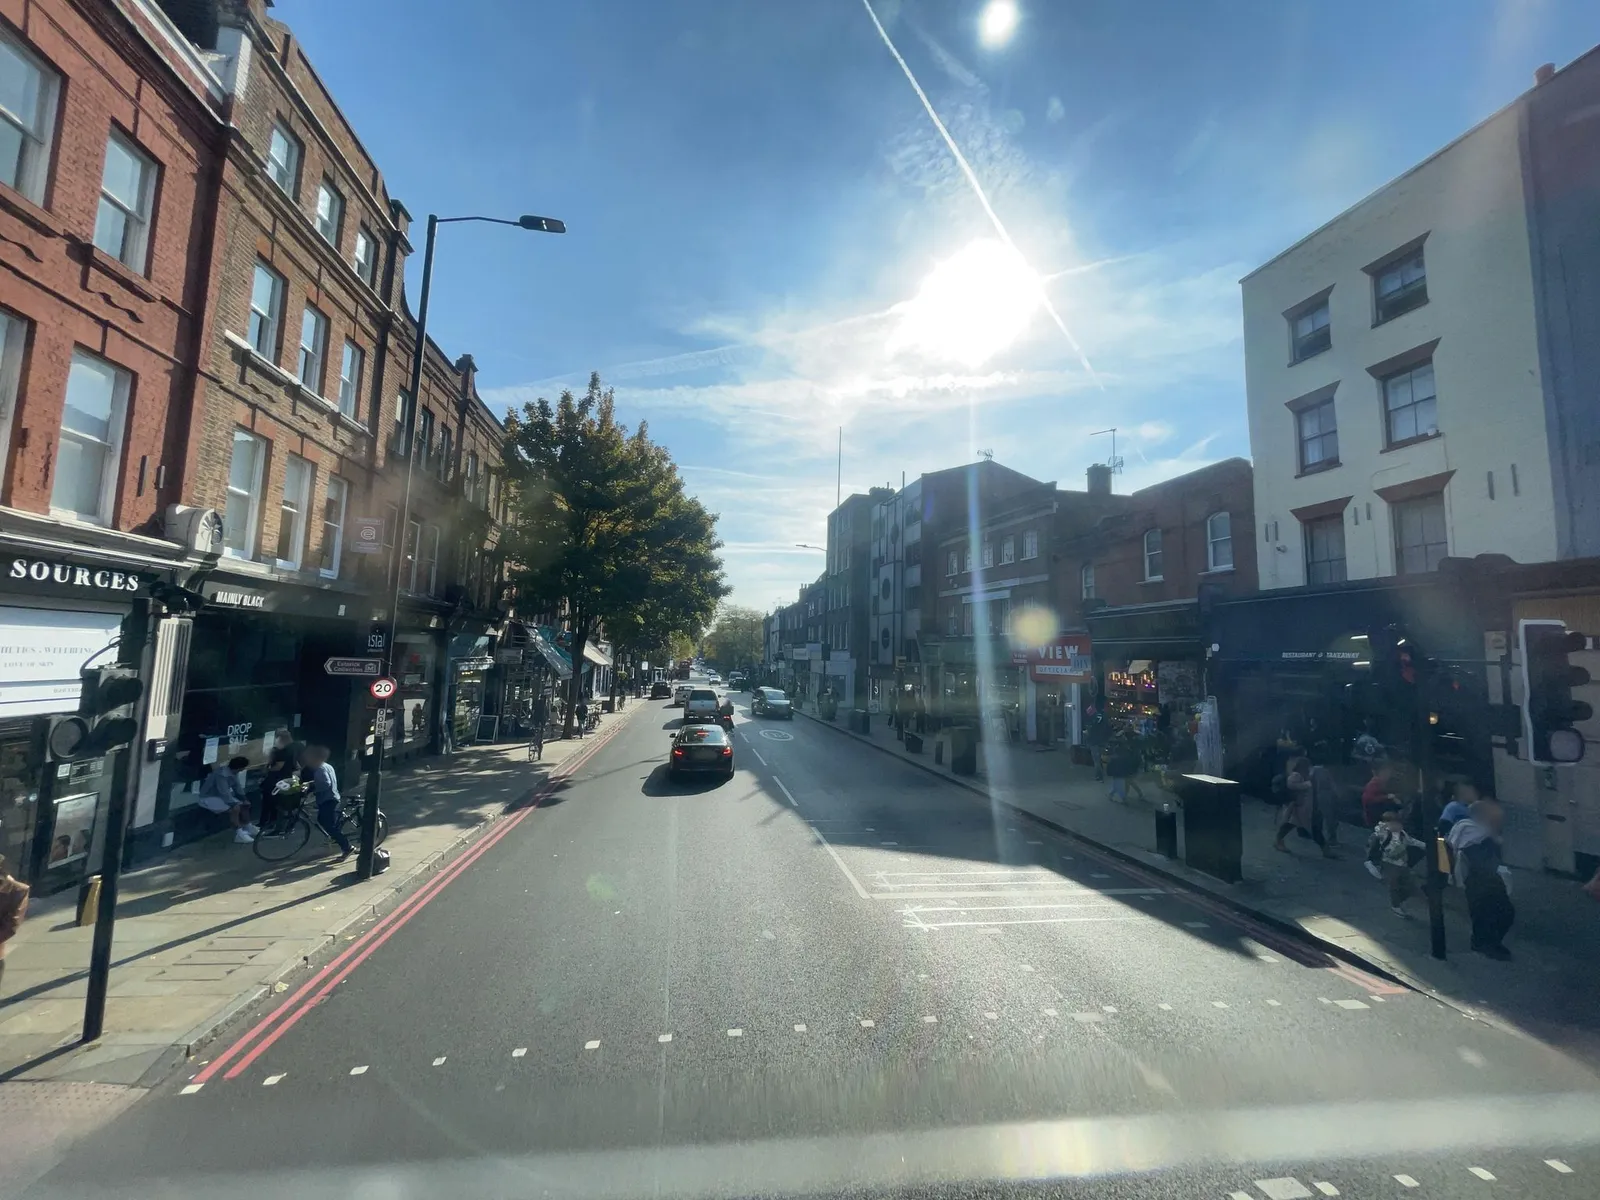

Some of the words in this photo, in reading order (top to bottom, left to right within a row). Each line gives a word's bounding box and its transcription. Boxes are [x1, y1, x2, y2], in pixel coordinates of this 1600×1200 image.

[9, 558, 139, 591] SOURCES
[216, 591, 243, 605] MAINLY
[242, 595, 265, 608] BLACK
[1038, 645, 1079, 659] VIEW
[375, 683, 392, 693] 20
[227, 722, 253, 736] DROP
[229, 734, 249, 747] SALE
